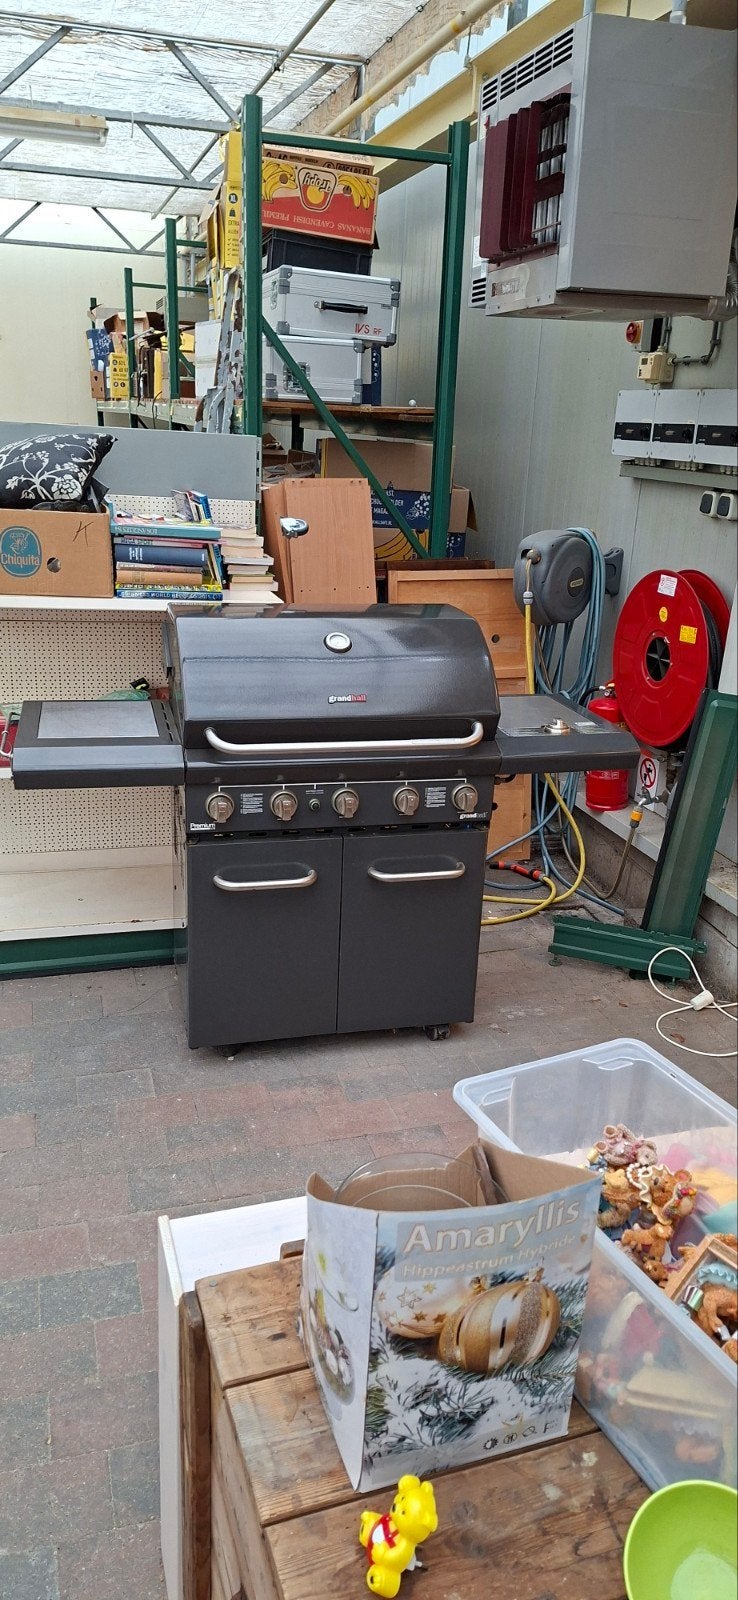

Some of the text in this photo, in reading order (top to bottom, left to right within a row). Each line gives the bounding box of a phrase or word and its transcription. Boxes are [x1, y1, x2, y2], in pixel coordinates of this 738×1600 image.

[302, 171, 331, 192] Tropy
[293, 214, 334, 229] CAVENDISH
[338, 222, 371, 235] BANANAS
[0, 553, 39, 568] Chiquita
[329, 695, 366, 704] grandhall
[403, 1199, 581, 1254] Amaryllis
[403, 1234, 576, 1278] Hippeastrum Hybride
